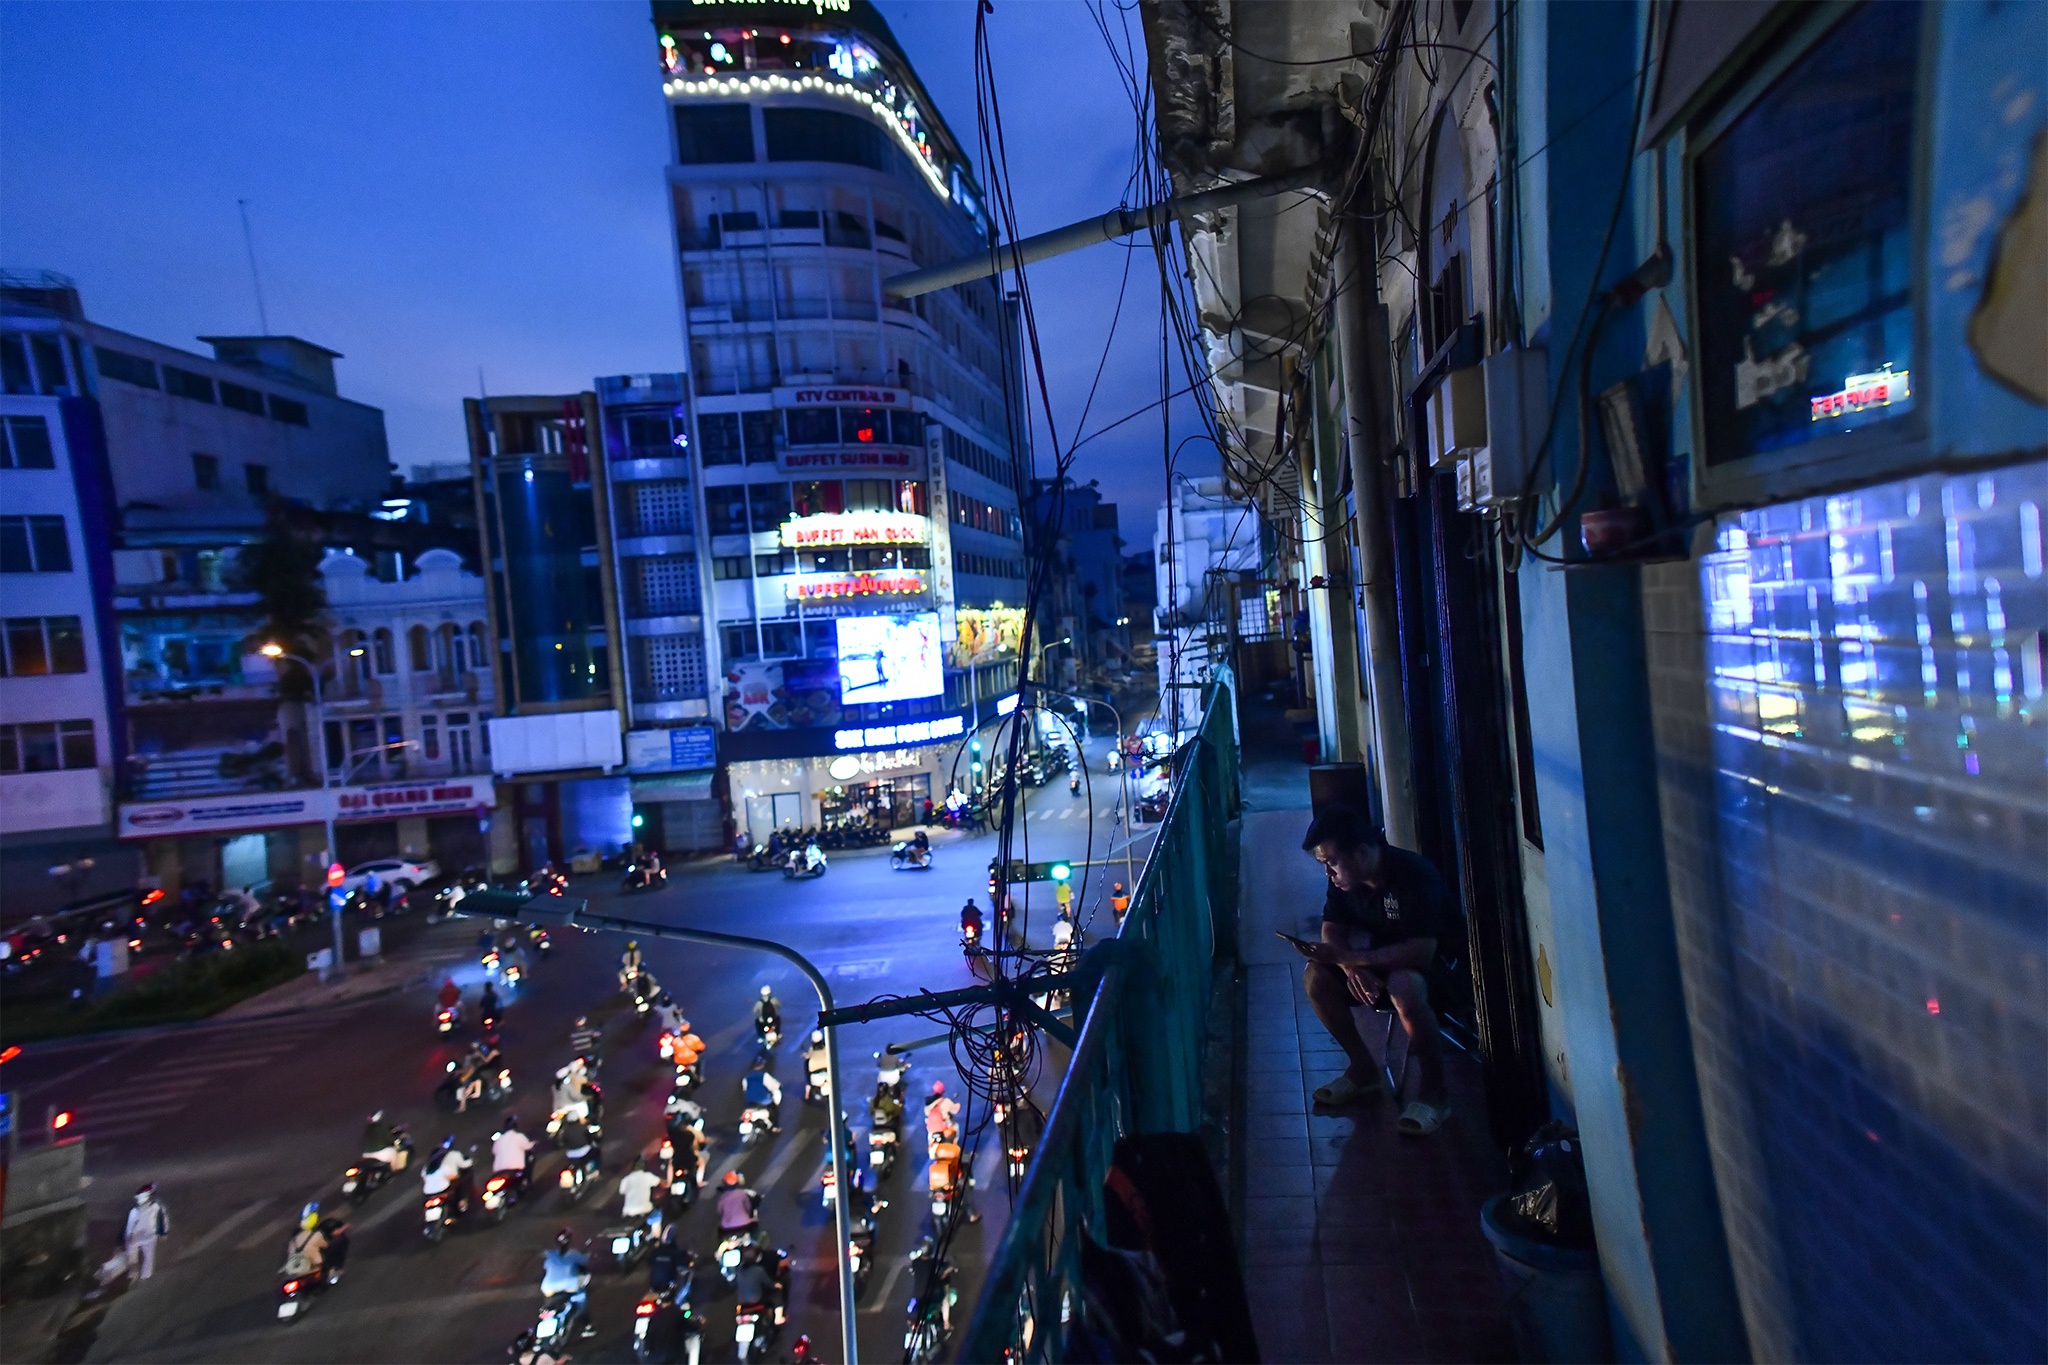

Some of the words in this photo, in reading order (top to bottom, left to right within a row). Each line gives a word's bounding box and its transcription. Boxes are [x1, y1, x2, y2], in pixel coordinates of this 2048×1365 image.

[796, 391, 823, 403] KTV
[825, 390, 881, 403] CENTRAL
[786, 453, 836, 467] BUFFET
[840, 453, 880, 465] SUSHI
[796, 528, 843, 543] BUFFET
[798, 580, 849, 595] BUFFET
